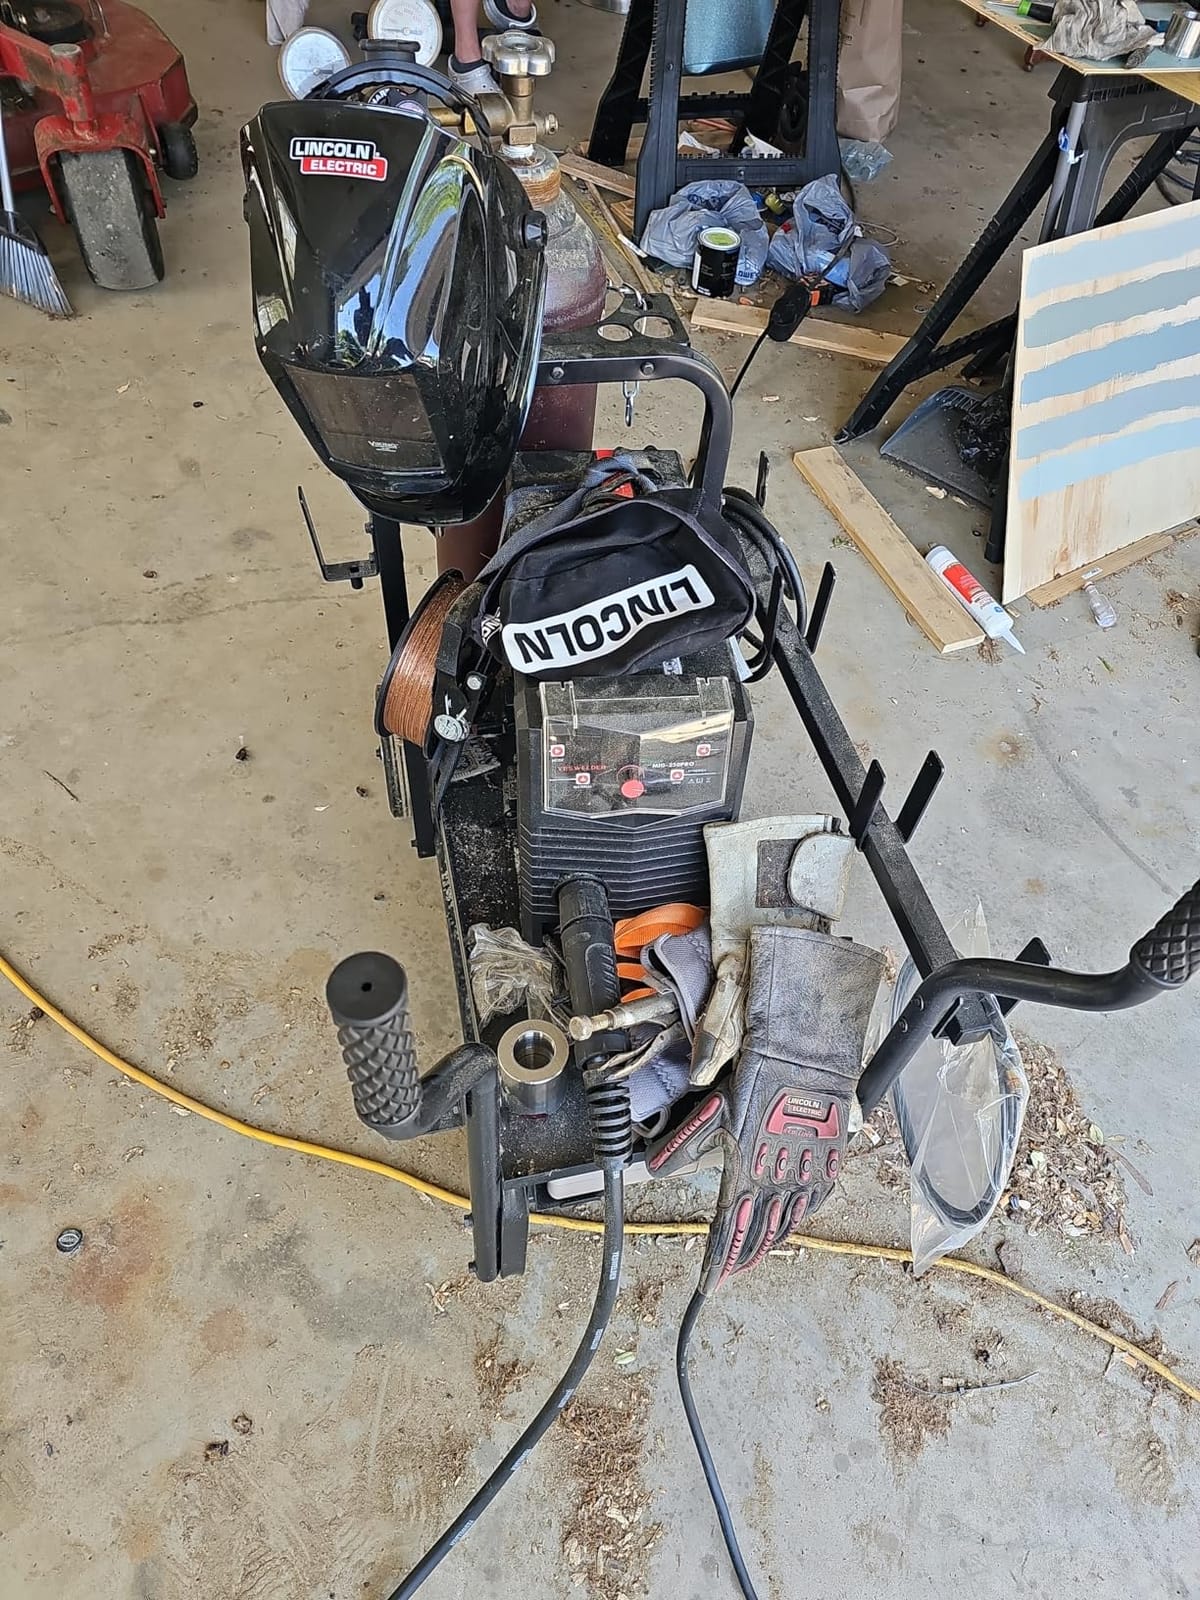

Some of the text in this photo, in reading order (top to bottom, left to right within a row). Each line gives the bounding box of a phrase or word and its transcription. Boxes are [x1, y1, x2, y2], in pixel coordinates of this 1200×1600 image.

[295, 141, 371, 160] LINCOLN
[310, 159, 377, 175] ELECTRIC
[513, 577, 702, 664] LINCOLN
[787, 1097, 821, 1108] LINCOLN
[792, 1106, 823, 1116] ELECTRIC
